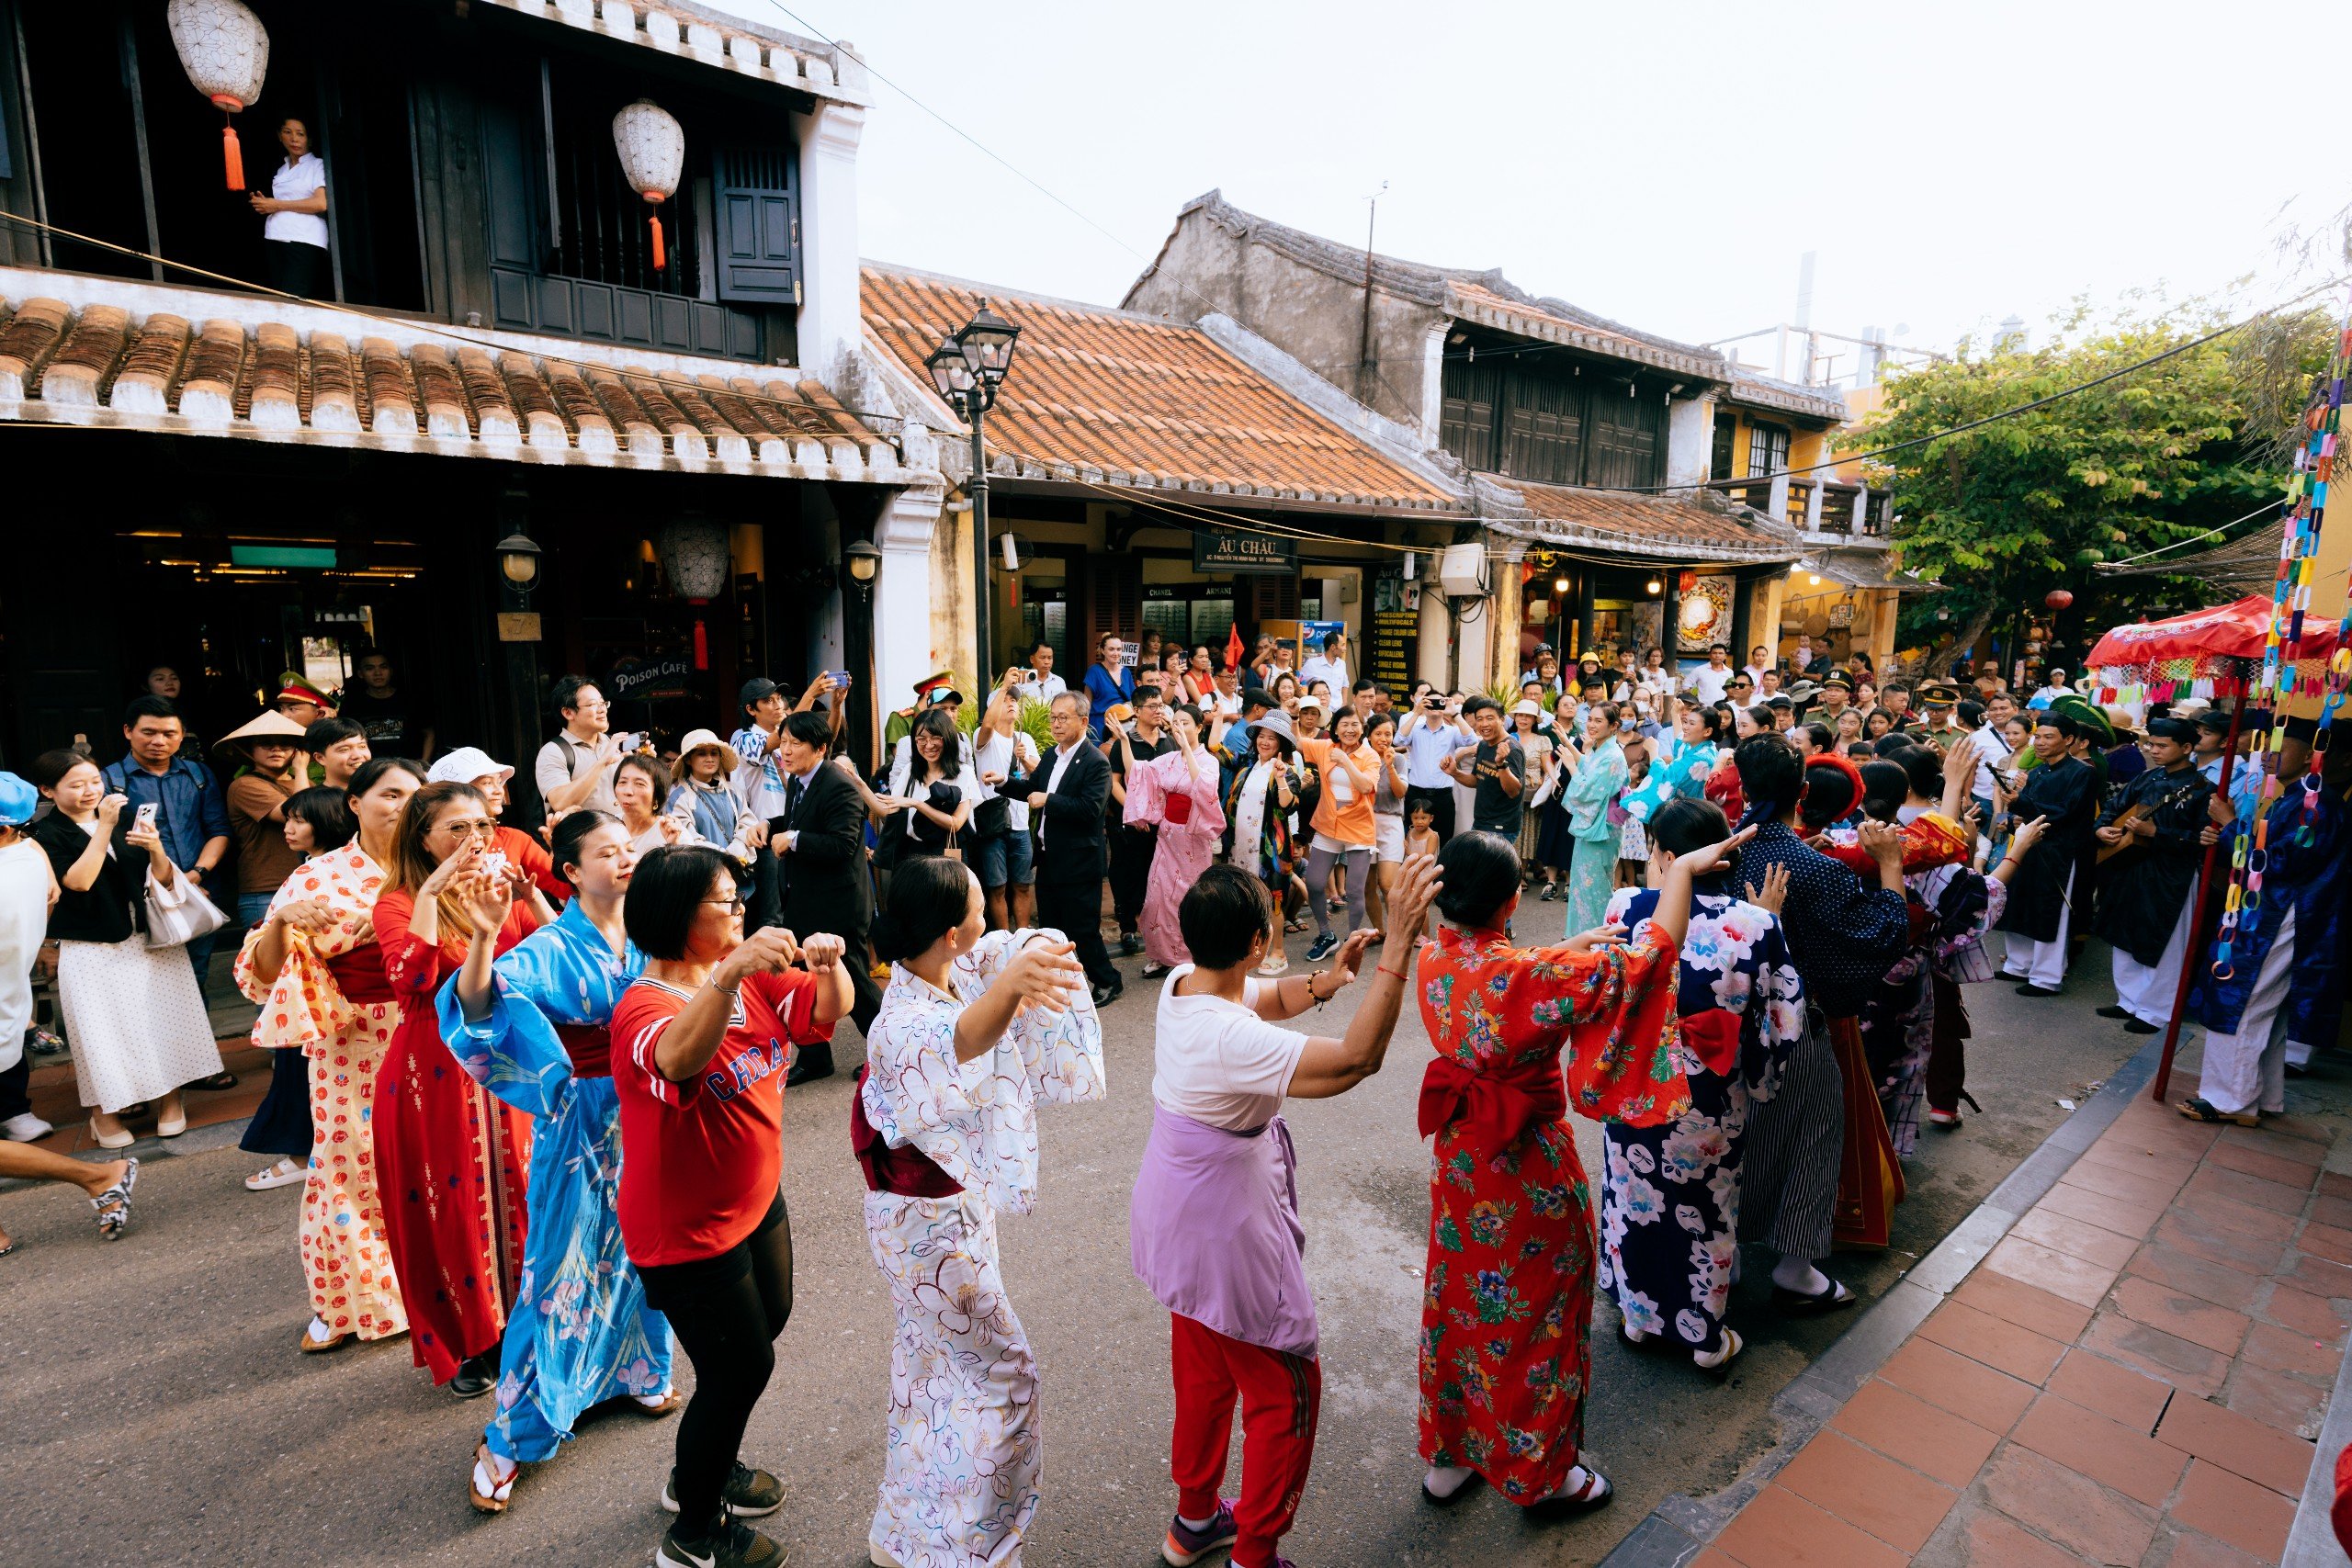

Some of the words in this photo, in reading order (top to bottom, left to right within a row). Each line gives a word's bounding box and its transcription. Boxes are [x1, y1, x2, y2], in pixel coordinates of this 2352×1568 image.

[1218, 536, 1236, 553] ÂU
[1240, 538, 1276, 555] CHÂU
[1206, 587, 1232, 595] ARMANI
[1117, 655, 1136, 664] NEY
[616, 667, 659, 693] POISON
[662, 661, 687, 675] CAFÉ
[706, 1037, 791, 1102] CHICA
